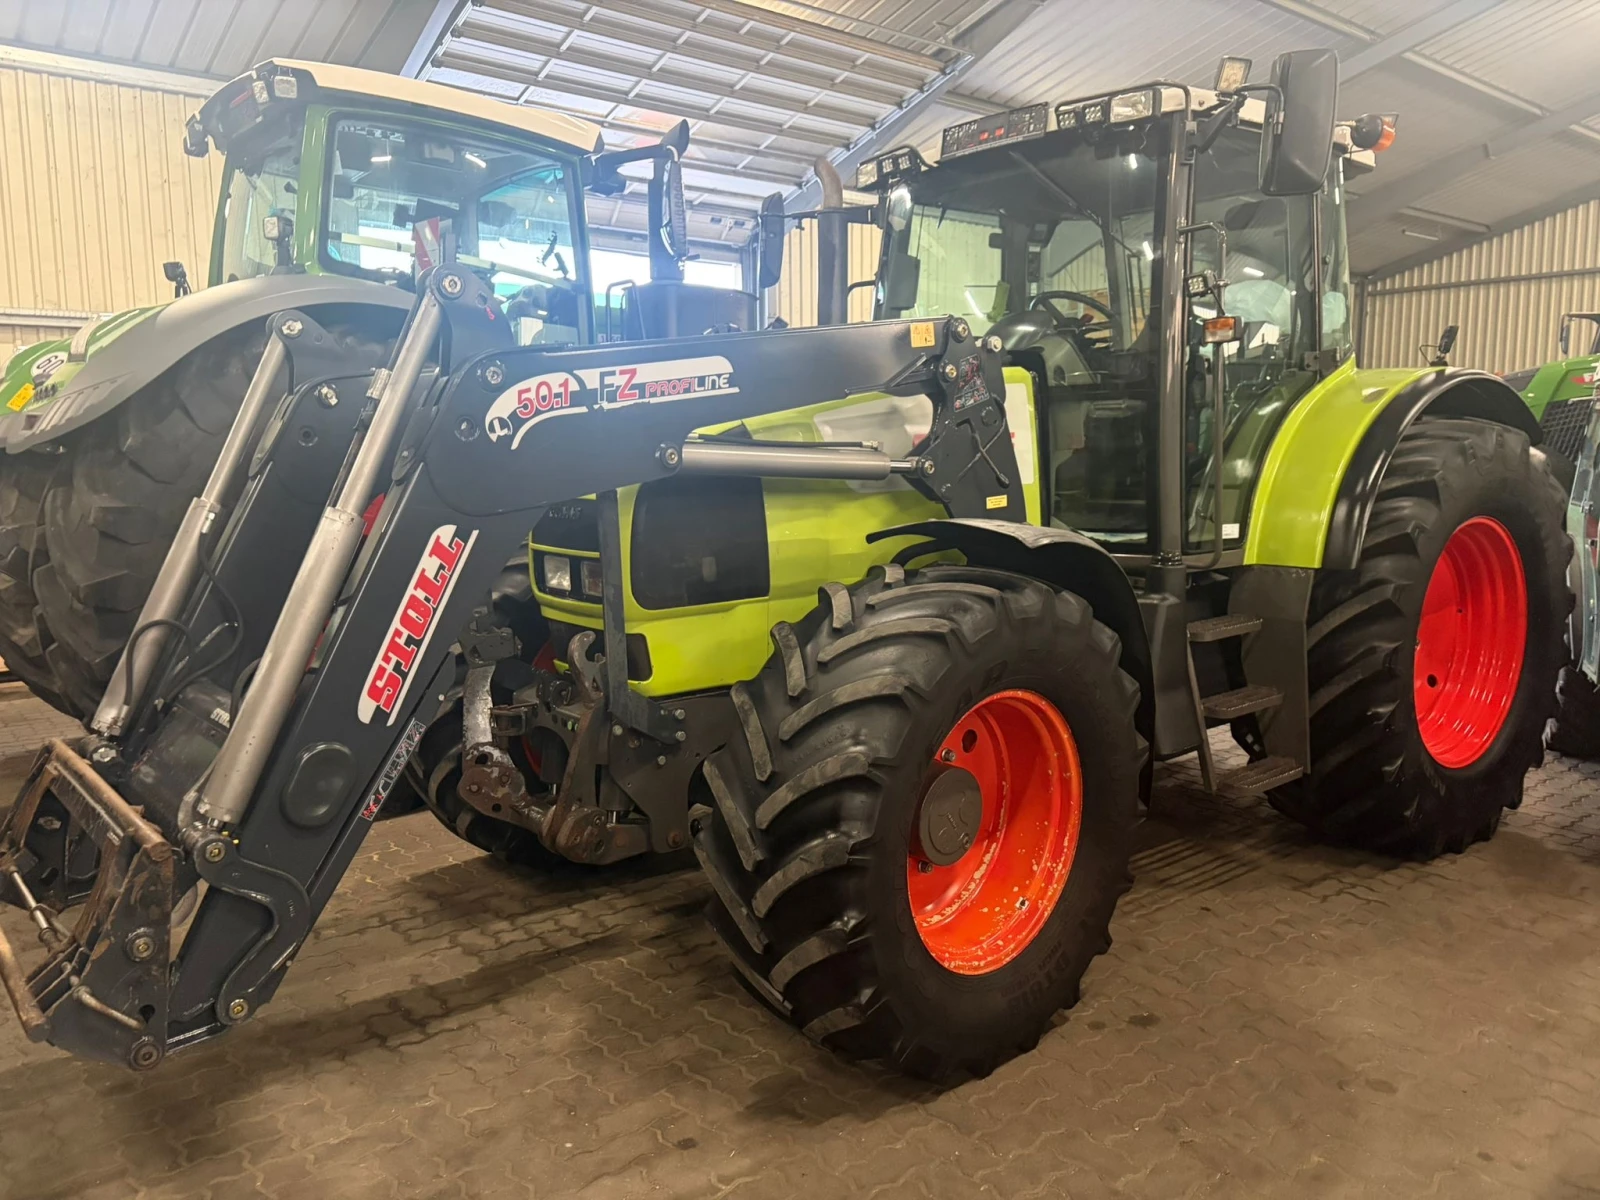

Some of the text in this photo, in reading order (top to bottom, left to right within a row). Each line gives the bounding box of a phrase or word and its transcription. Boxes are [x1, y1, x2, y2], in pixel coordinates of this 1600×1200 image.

[36, 355, 65, 374] 60
[516, 367, 730, 418] 50.1 FZ PROFILINE
[367, 535, 465, 714] STOLL
